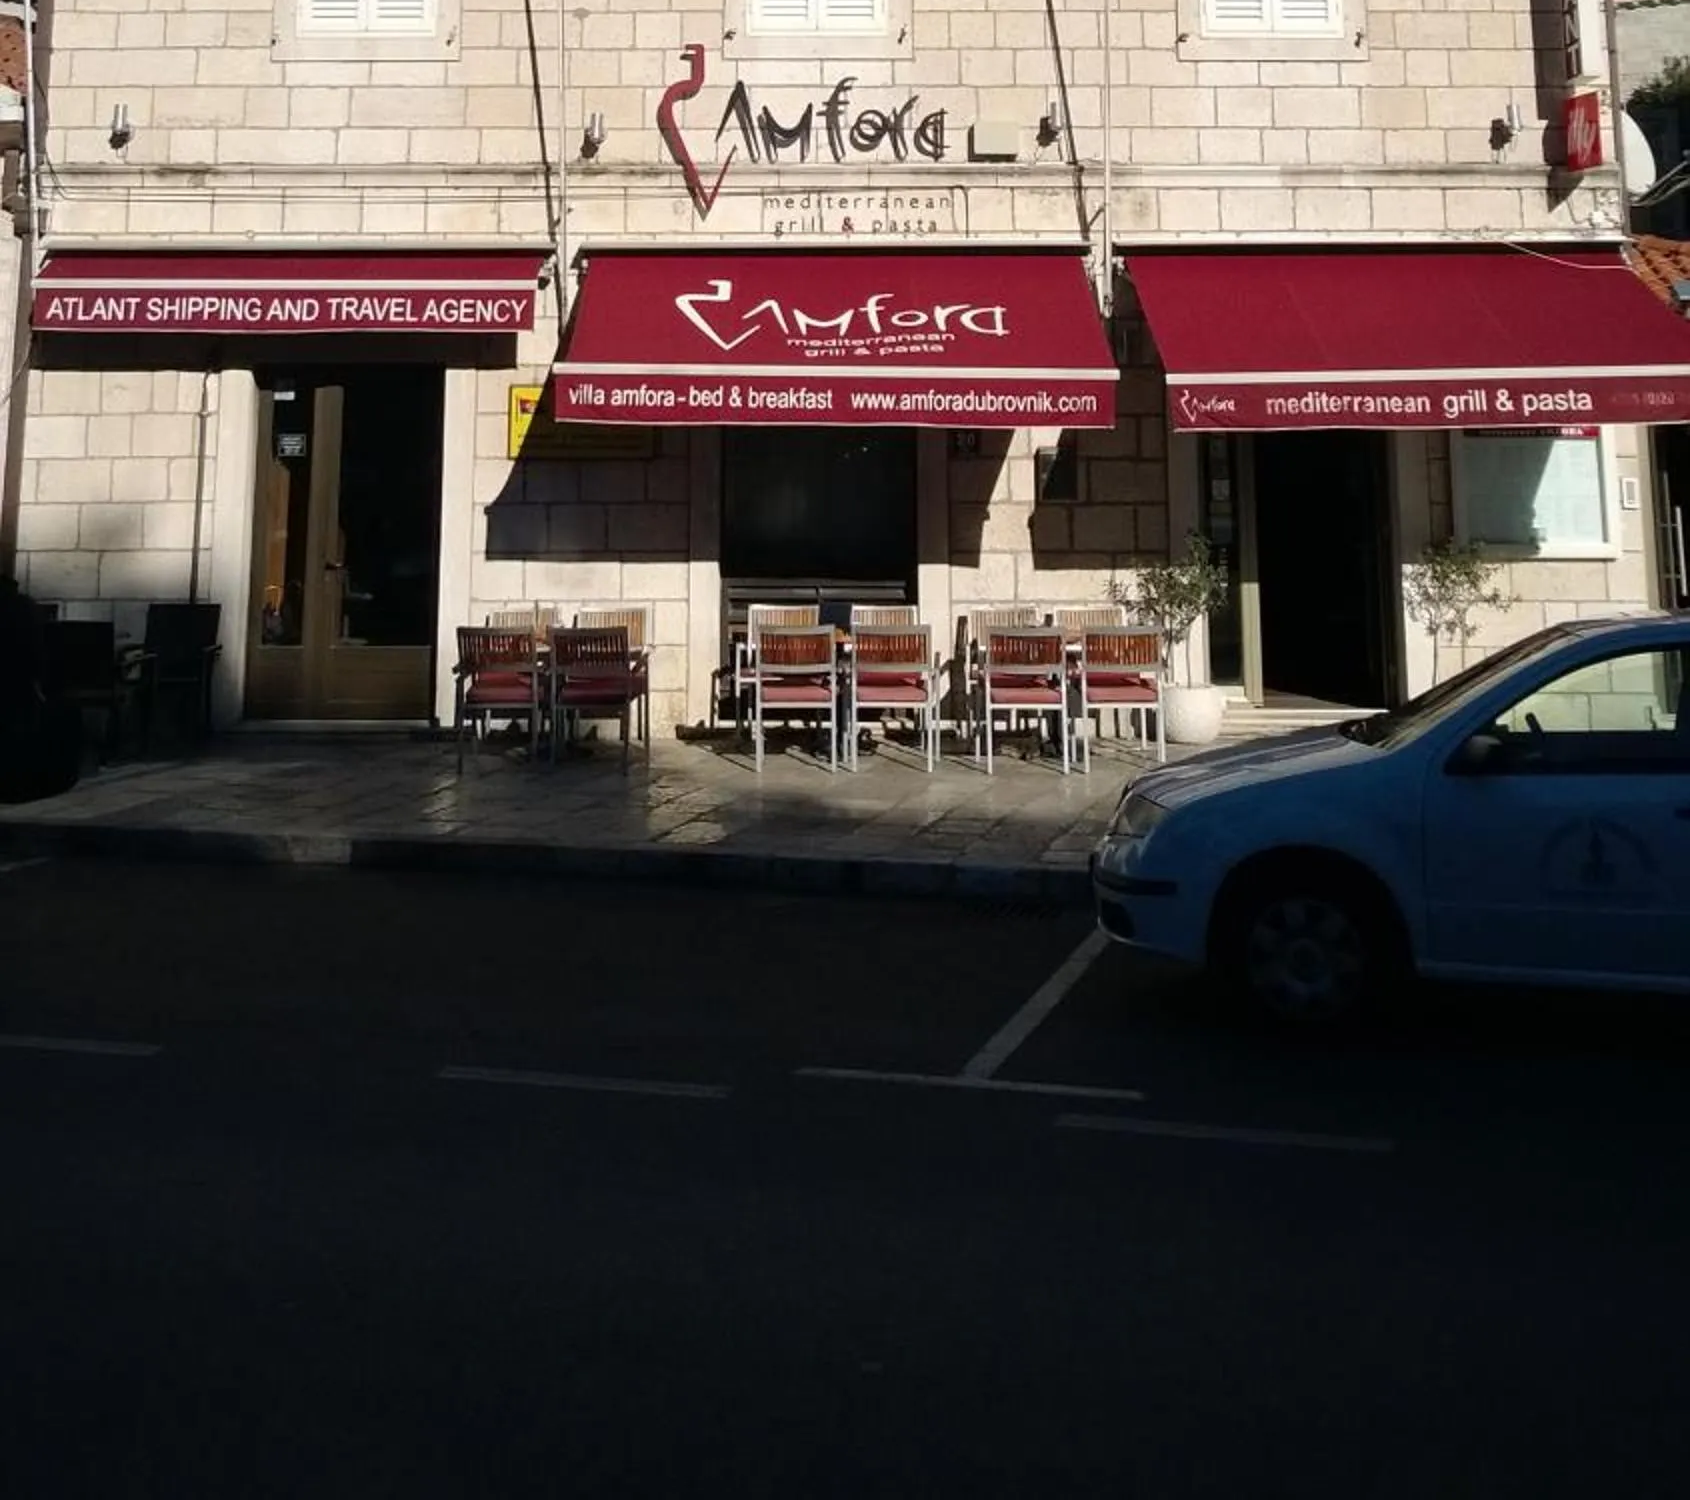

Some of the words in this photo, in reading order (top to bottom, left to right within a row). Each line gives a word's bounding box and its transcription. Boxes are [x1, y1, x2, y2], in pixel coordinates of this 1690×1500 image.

[1567, 107, 1597, 165] illy
[764, 191, 951, 209] mediterranean
[775, 216, 824, 236] grill
[841, 216, 855, 233] &
[872, 217, 938, 235] pasta
[46, 297, 141, 321] ATLANT
[146, 297, 262, 321] SHIPPING
[266, 298, 319, 321] AND
[326, 297, 419, 322] TRAVEL
[422, 298, 528, 323] AGENCY
[787, 332, 955, 347] mediterranean
[804, 347, 846, 357] grill
[853, 346, 871, 355] &
[879, 343, 945, 356] pasta
[568, 384, 605, 406] villa
[728, 385, 743, 408] &
[748, 386, 833, 410] breakfast
[850, 389, 1097, 413] www.amforadubrovnik.com
[1265, 391, 1431, 415] mediterranean
[1443, 389, 1487, 418] grill
[1495, 388, 1514, 412] &
[1522, 389, 1593, 416] pasta
